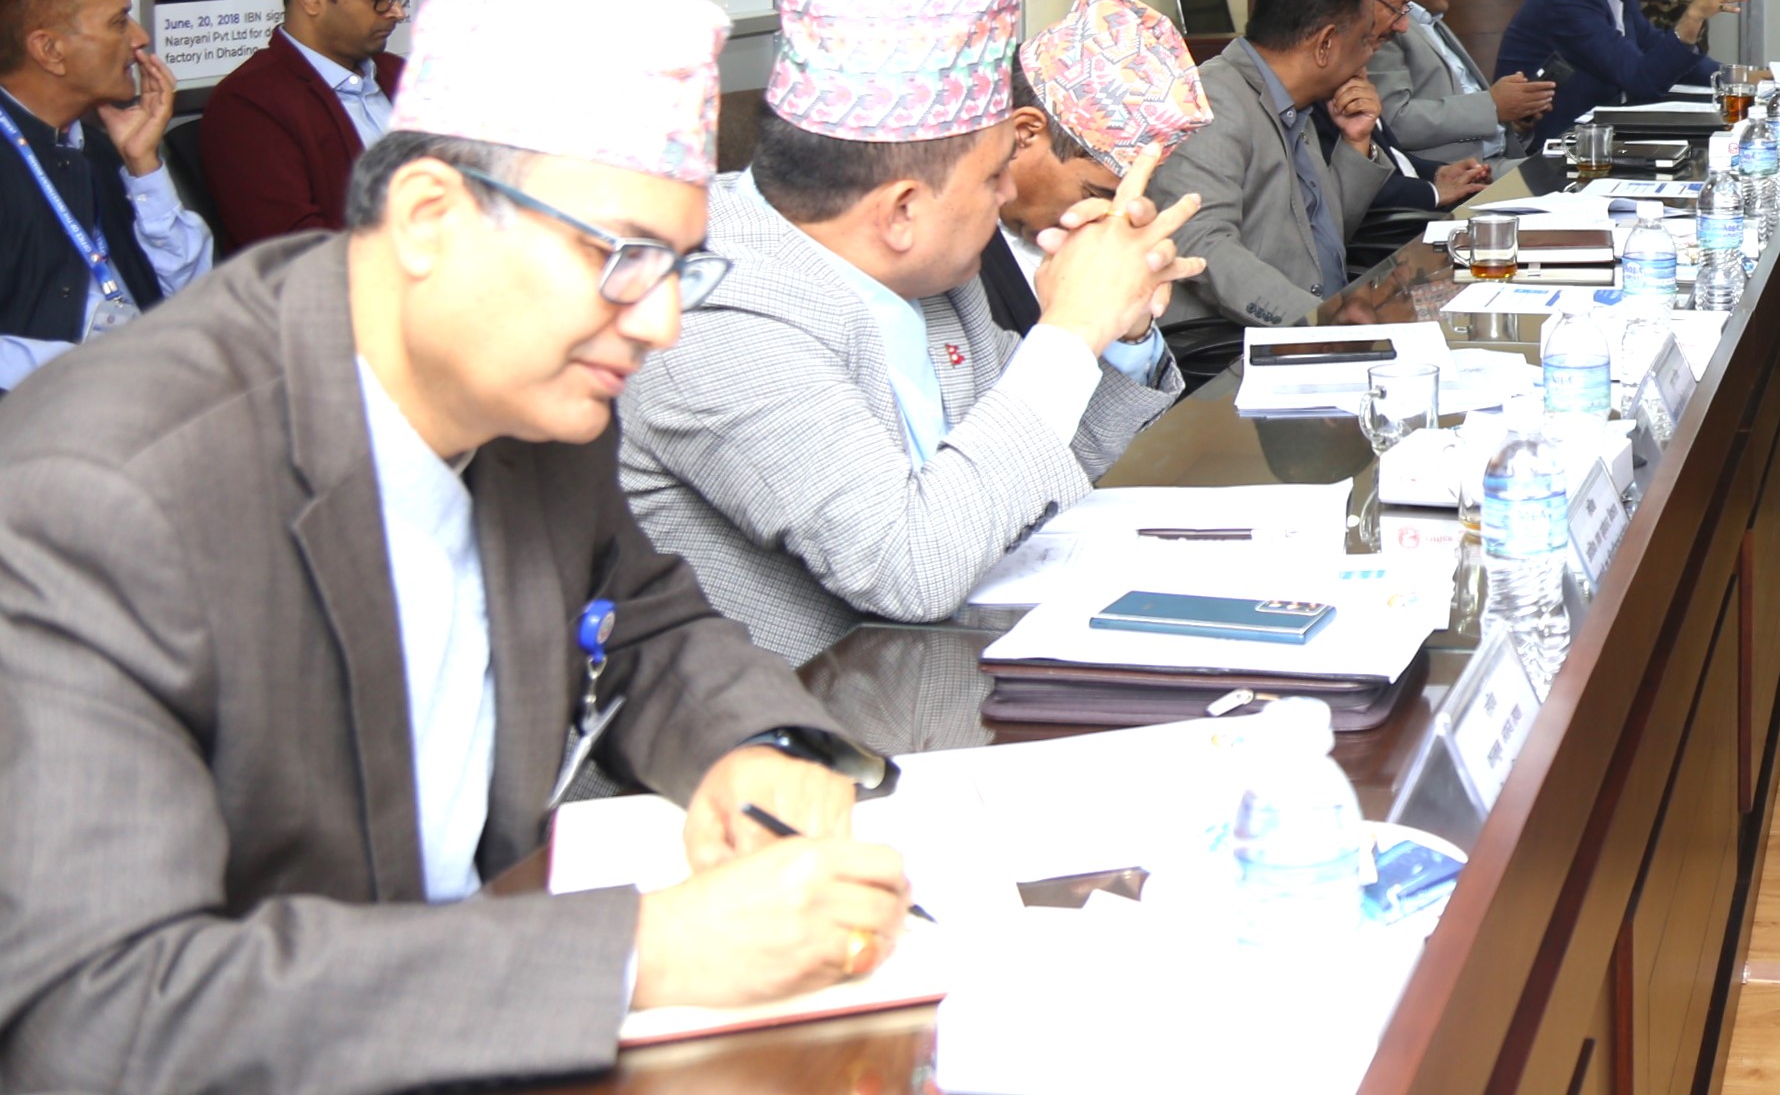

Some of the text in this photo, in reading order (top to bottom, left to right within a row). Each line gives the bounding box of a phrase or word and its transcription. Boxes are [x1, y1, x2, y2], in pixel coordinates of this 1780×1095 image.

[164, 17, 194, 30] June,
[197, 15, 213, 28] 20,
[217, 13, 240, 26] 2018
[244, 11, 262, 24] IBN
[165, 31, 211, 48] Narayani
[213, 31, 230, 43] Pvt
[231, 29, 247, 41] Ltd
[249, 28, 263, 40] for
[165, 49, 202, 64] factory
[204, 48, 214, 60] in
